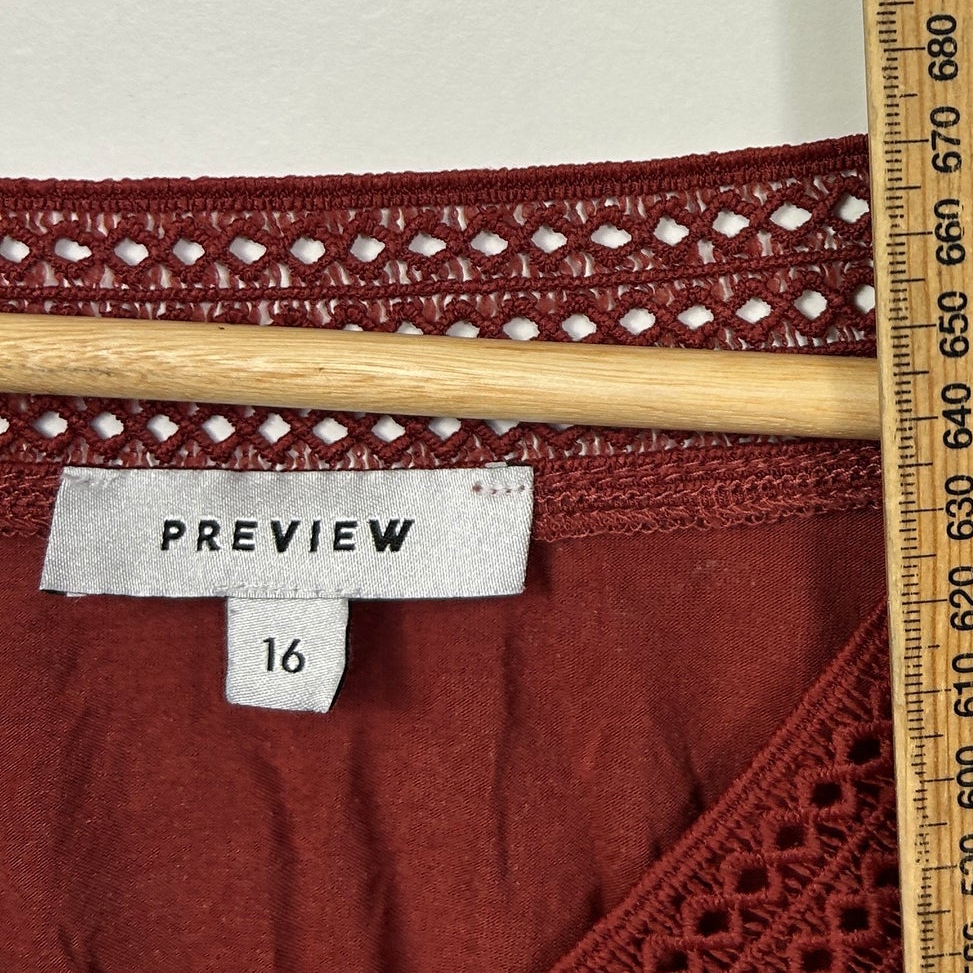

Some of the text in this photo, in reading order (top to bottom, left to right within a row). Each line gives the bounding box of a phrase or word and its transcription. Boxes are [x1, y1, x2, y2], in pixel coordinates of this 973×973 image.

[926, 14, 959, 82] 680
[929, 106, 963, 174] 670
[933, 198, 966, 267] 660
[937, 290, 970, 359] 650
[940, 382, 973, 450] 640
[160, 518, 415, 554] PREVIEW
[262, 637, 306, 674] 16
